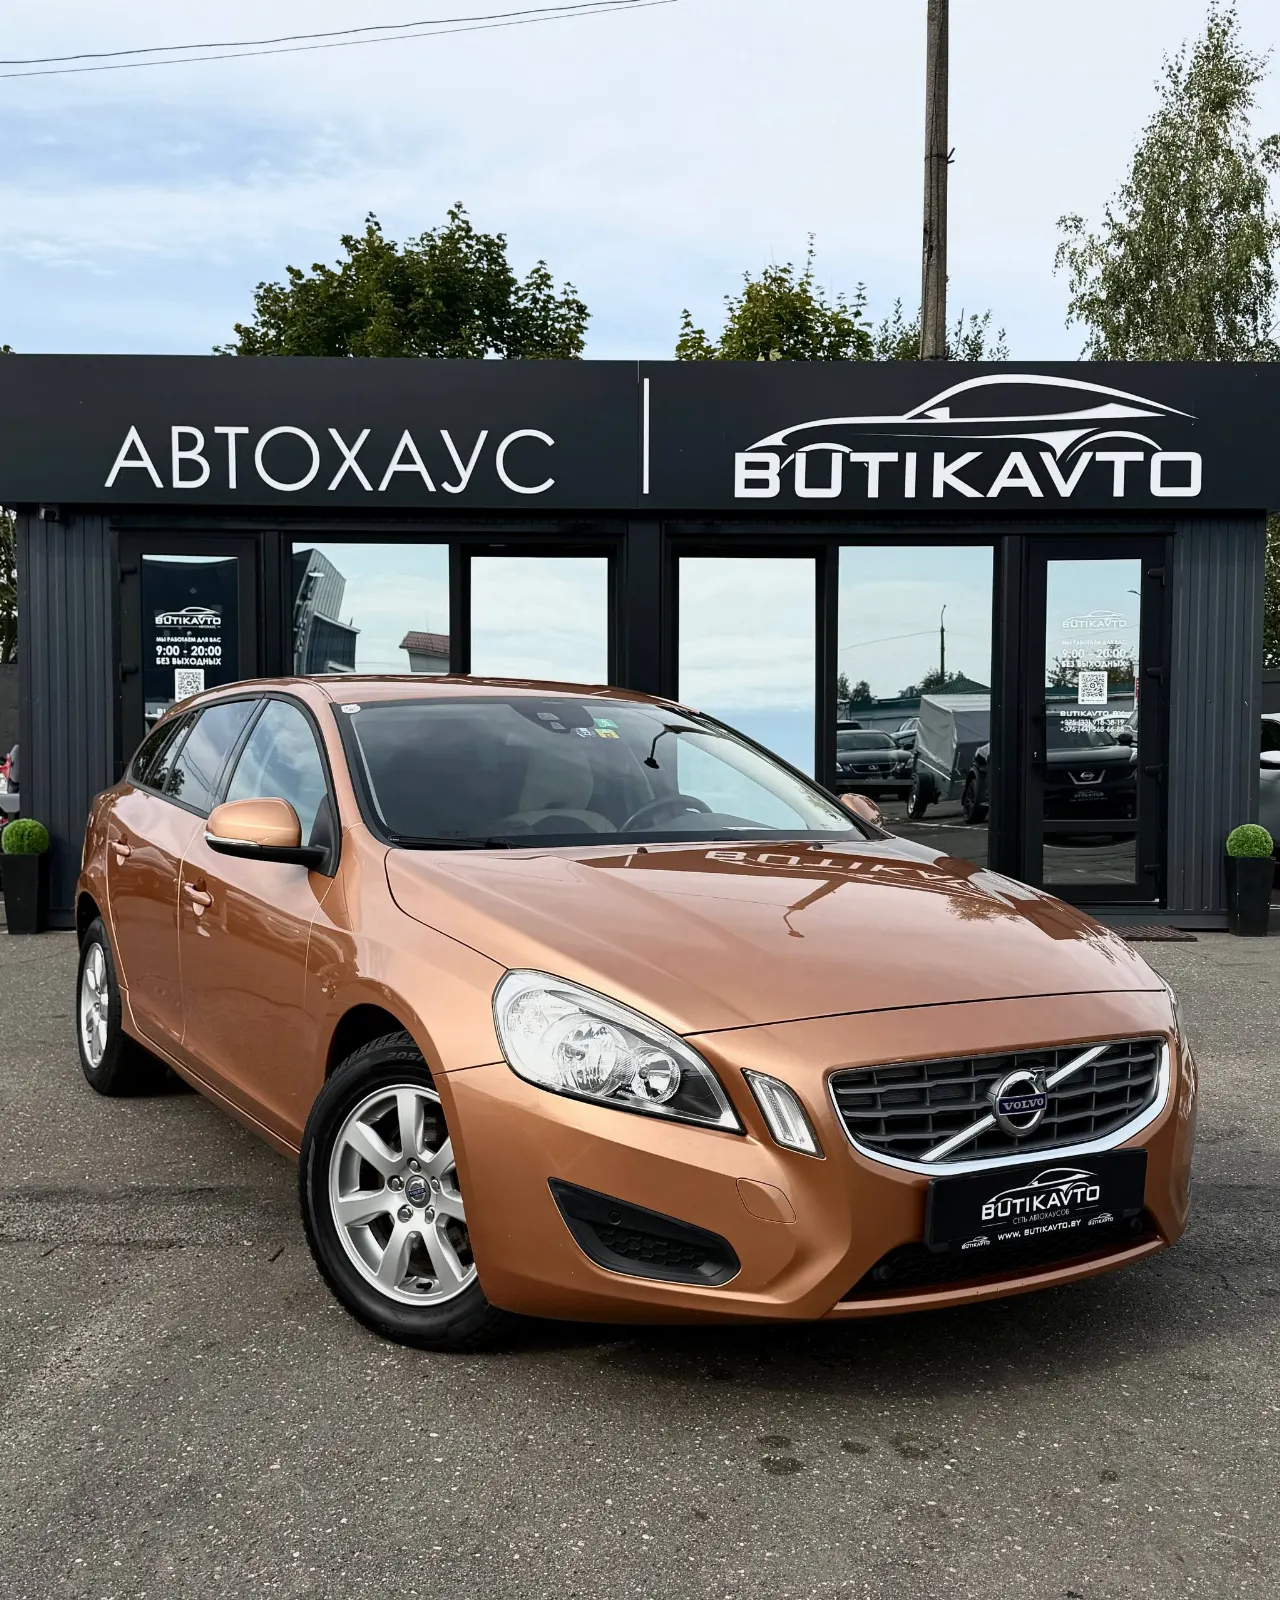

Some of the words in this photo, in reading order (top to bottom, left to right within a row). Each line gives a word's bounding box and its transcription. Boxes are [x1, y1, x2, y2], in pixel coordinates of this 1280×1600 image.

[105, 426, 556, 494] АВТОХАУС
[734, 450, 1203, 499] BUTIKAVTO
[155, 616, 222, 625] BUTIKAVTO
[1062, 620, 1127, 628] BUTIKAVTO
[156, 645, 180, 656] 9:00
[191, 645, 222, 656] 20:00
[1062, 649, 1085, 659] 9:00
[1096, 649, 1126, 659] 20:00
[156, 657, 170, 665] БЕЗ
[172, 657, 222, 666] ВЫХОДНЫХ
[1061, 660, 1075, 668] БЕЗ
[1077, 660, 1127, 668] ВЫХОДНЫХ
[1003, 1098, 1044, 1111] VOLVO
[981, 1186, 1100, 1221] BUTIKAVTO
[1024, 1219, 1082, 1236] BUTIKAVTO.BY
